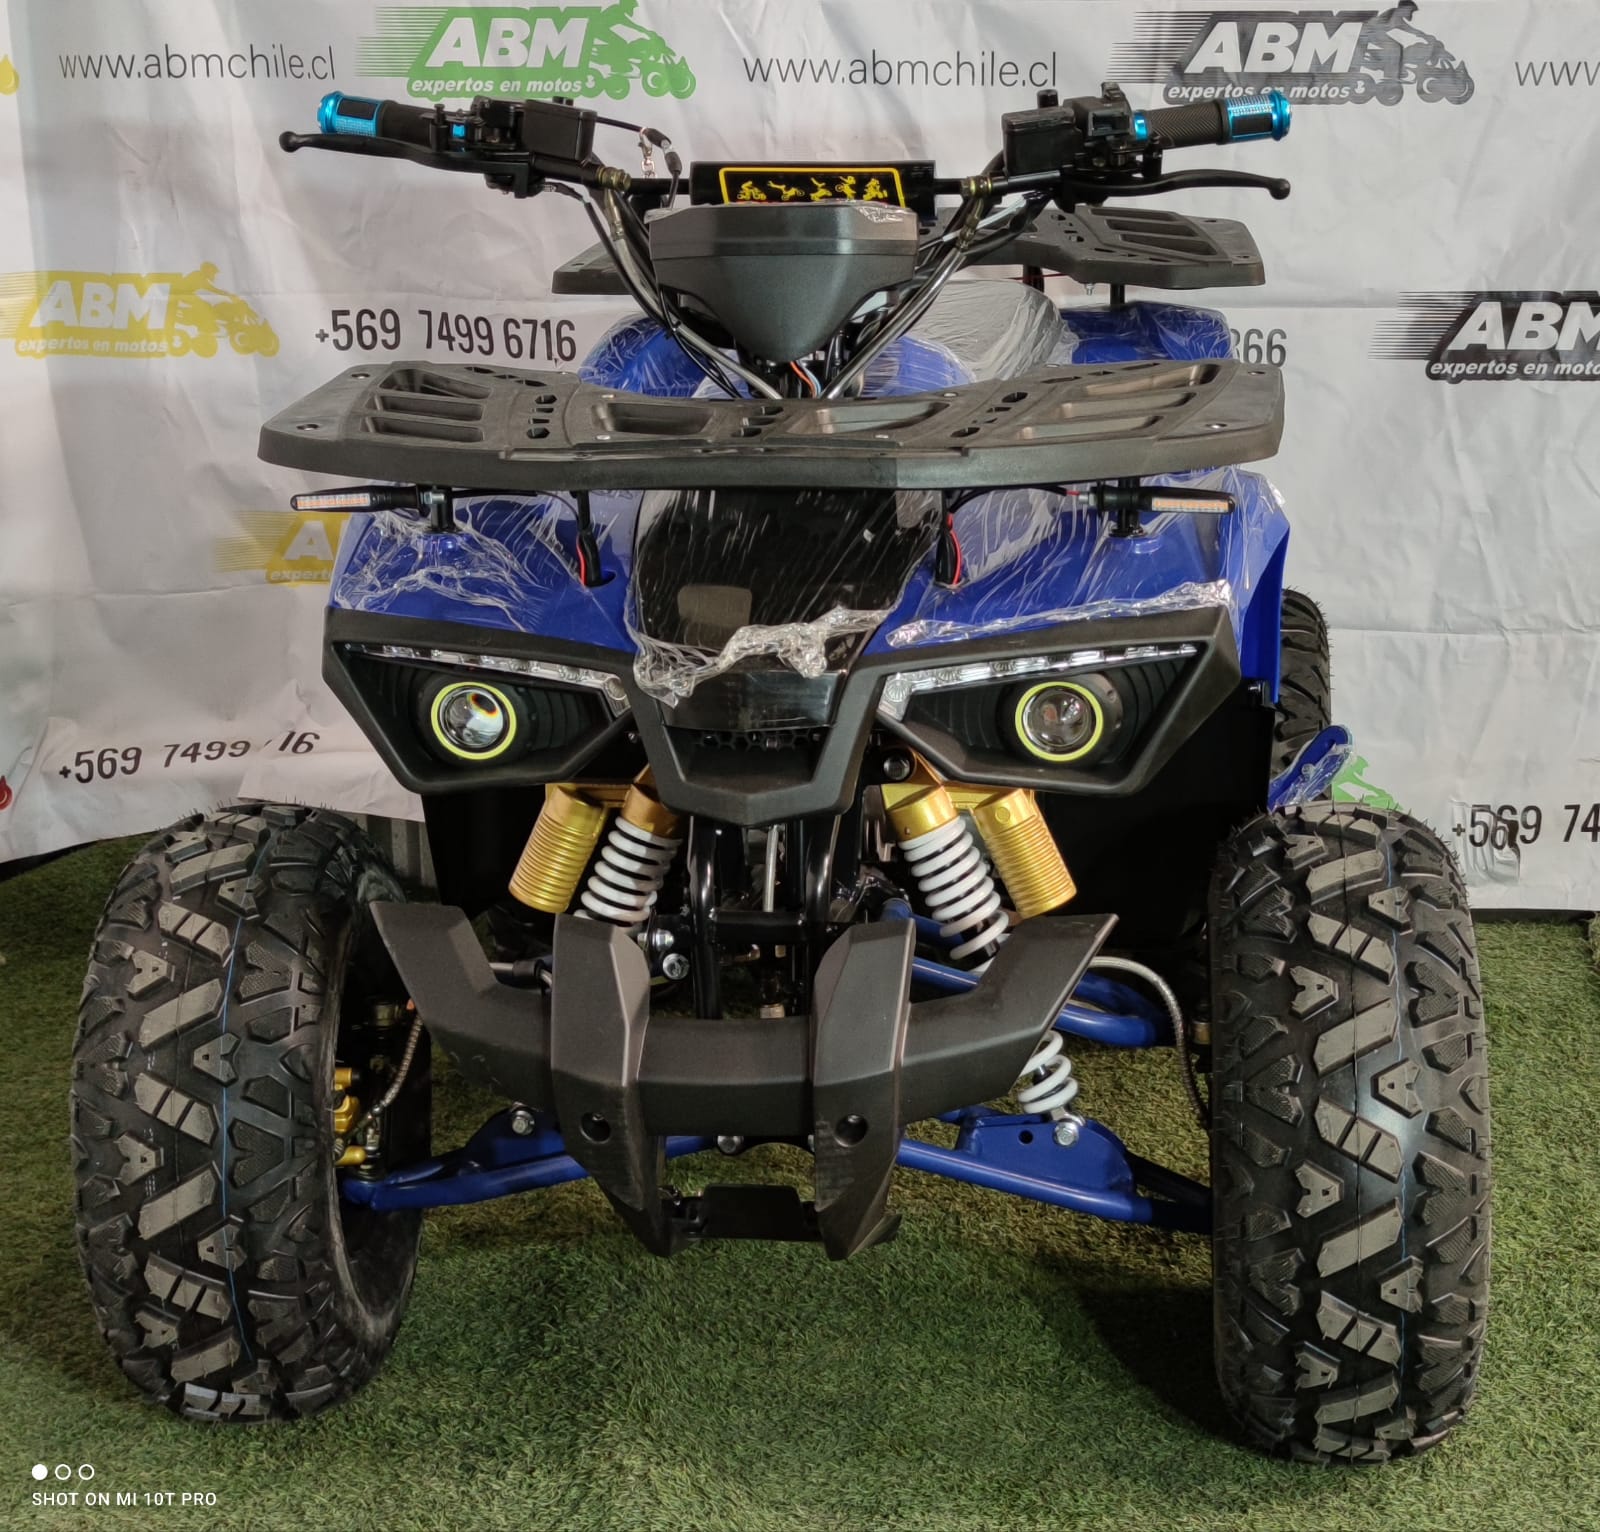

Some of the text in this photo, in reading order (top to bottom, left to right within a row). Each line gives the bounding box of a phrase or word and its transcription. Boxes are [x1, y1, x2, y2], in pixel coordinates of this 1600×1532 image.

[58, 43, 335, 81] www.abmchile.cl
[425, 17, 589, 68] ABM
[1184, 21, 1363, 73] ABM
[411, 77, 582, 95] expertos en motos
[743, 48, 1056, 88] www.abmchile.cl
[1167, 83, 1254, 102] expertos
[1289, 82, 1351, 98] motos
[29, 280, 171, 330] ABM
[1446, 301, 1600, 351] ABM
[19, 336, 169, 353] expertos en motos
[315, 308, 577, 362] +569 7499 6716
[1430, 360, 1518, 378] expertos
[1523, 362, 1547, 375] en
[59, 746, 142, 784] +569
[163, 740, 251, 768] 7499
[1452, 804, 1542, 850] +569
